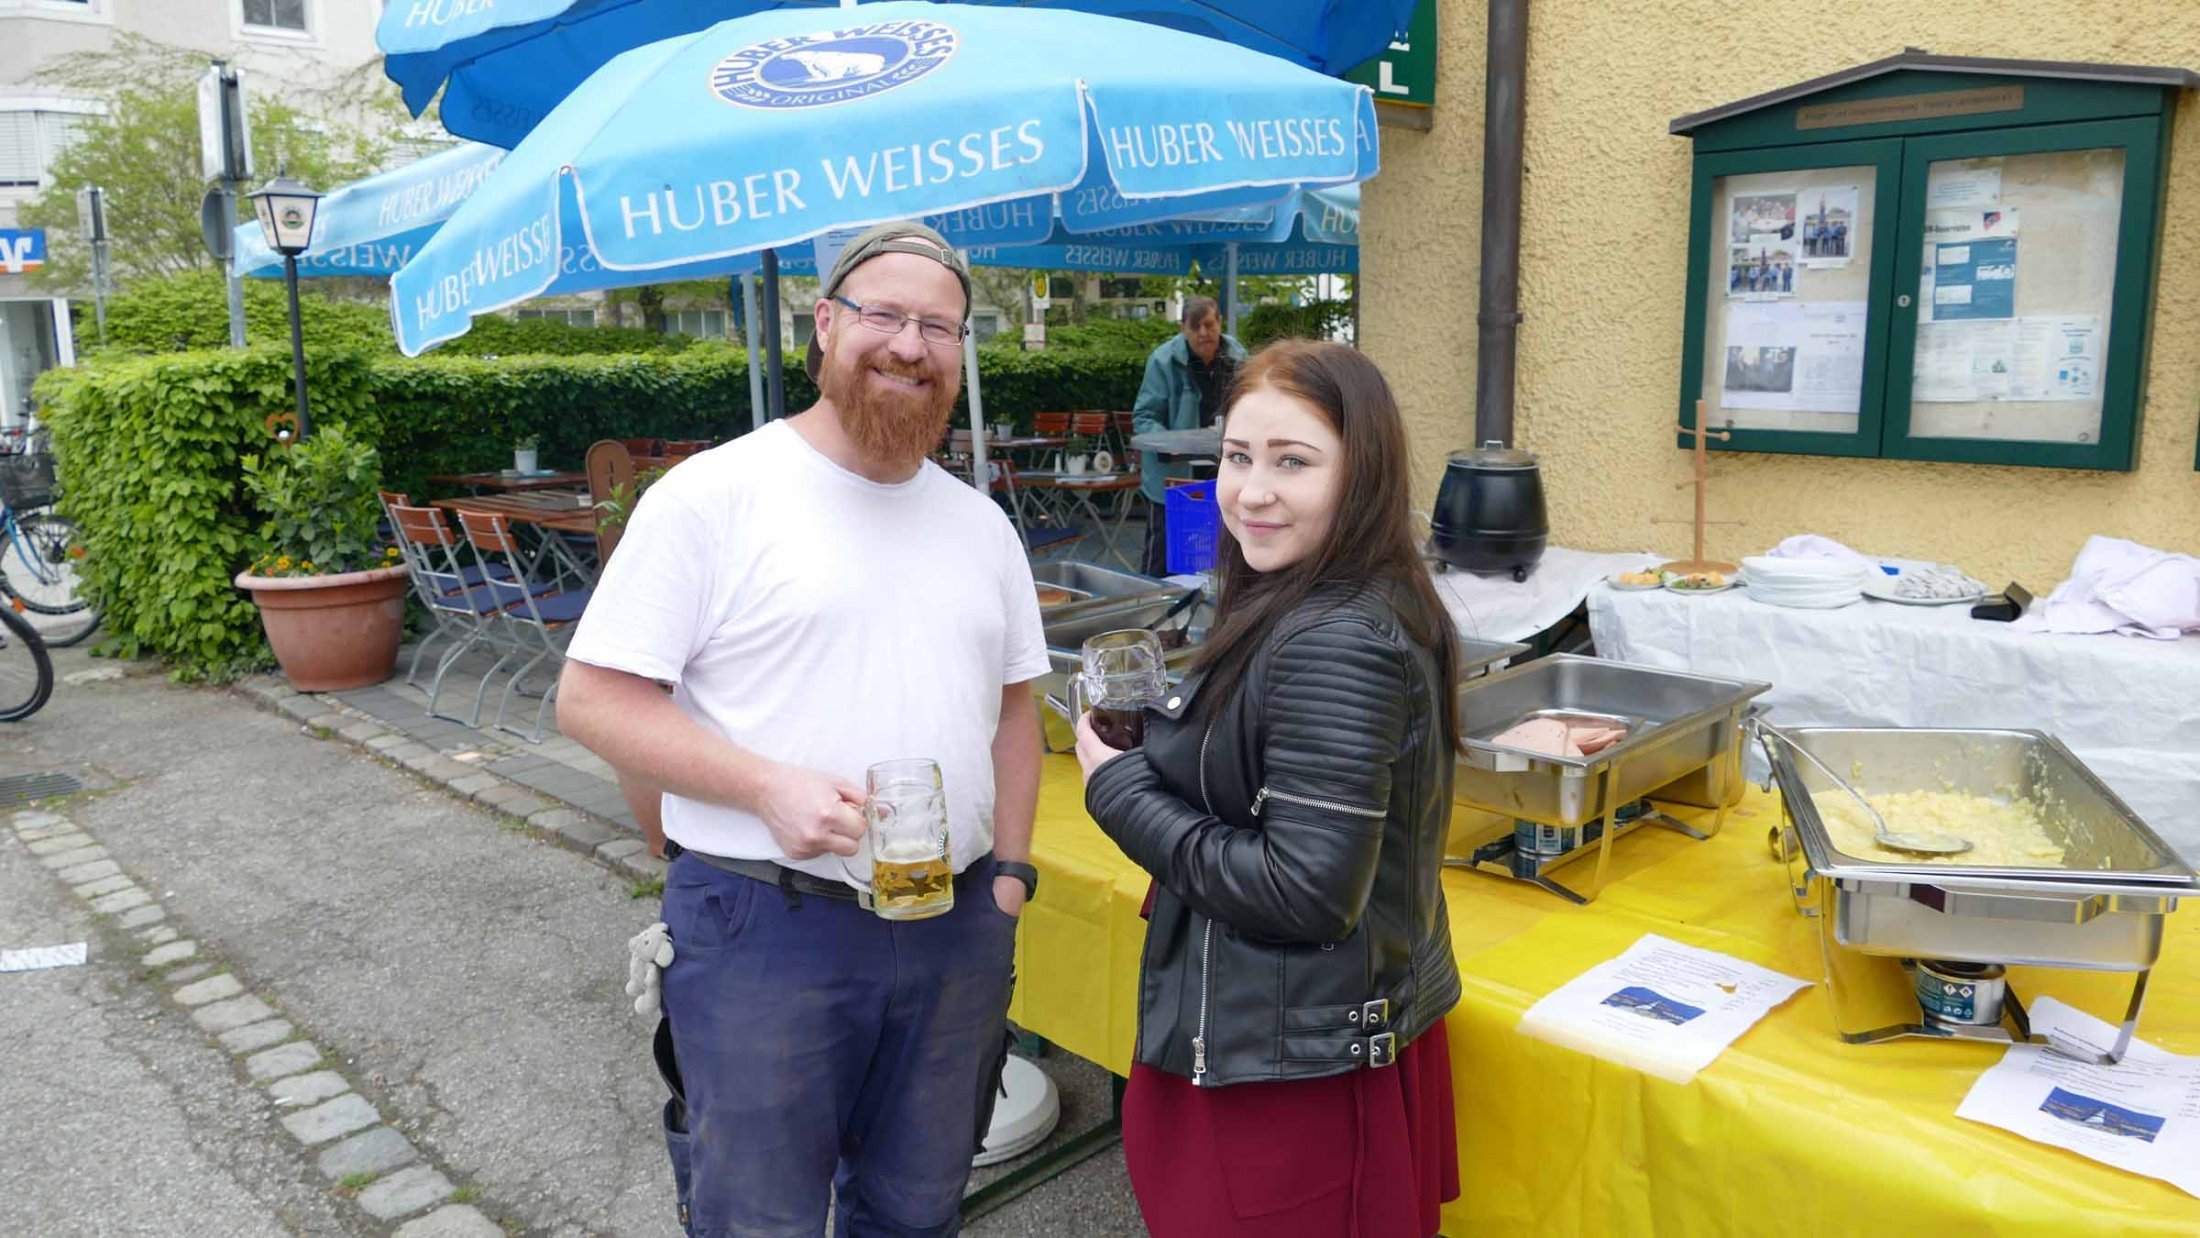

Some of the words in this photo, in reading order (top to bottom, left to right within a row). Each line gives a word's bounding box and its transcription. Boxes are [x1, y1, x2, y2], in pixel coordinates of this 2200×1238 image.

[713, 35, 819, 88] HUBER
[833, 21, 955, 58] WEISSES
[770, 79, 892, 106] ORIGINAL
[1110, 121, 1224, 170] HUBER
[1226, 118, 1346, 161] WEISSES
[620, 168, 808, 239] HUBER
[821, 118, 1046, 201] WEISSES
[475, 212, 551, 287] WEISSE
